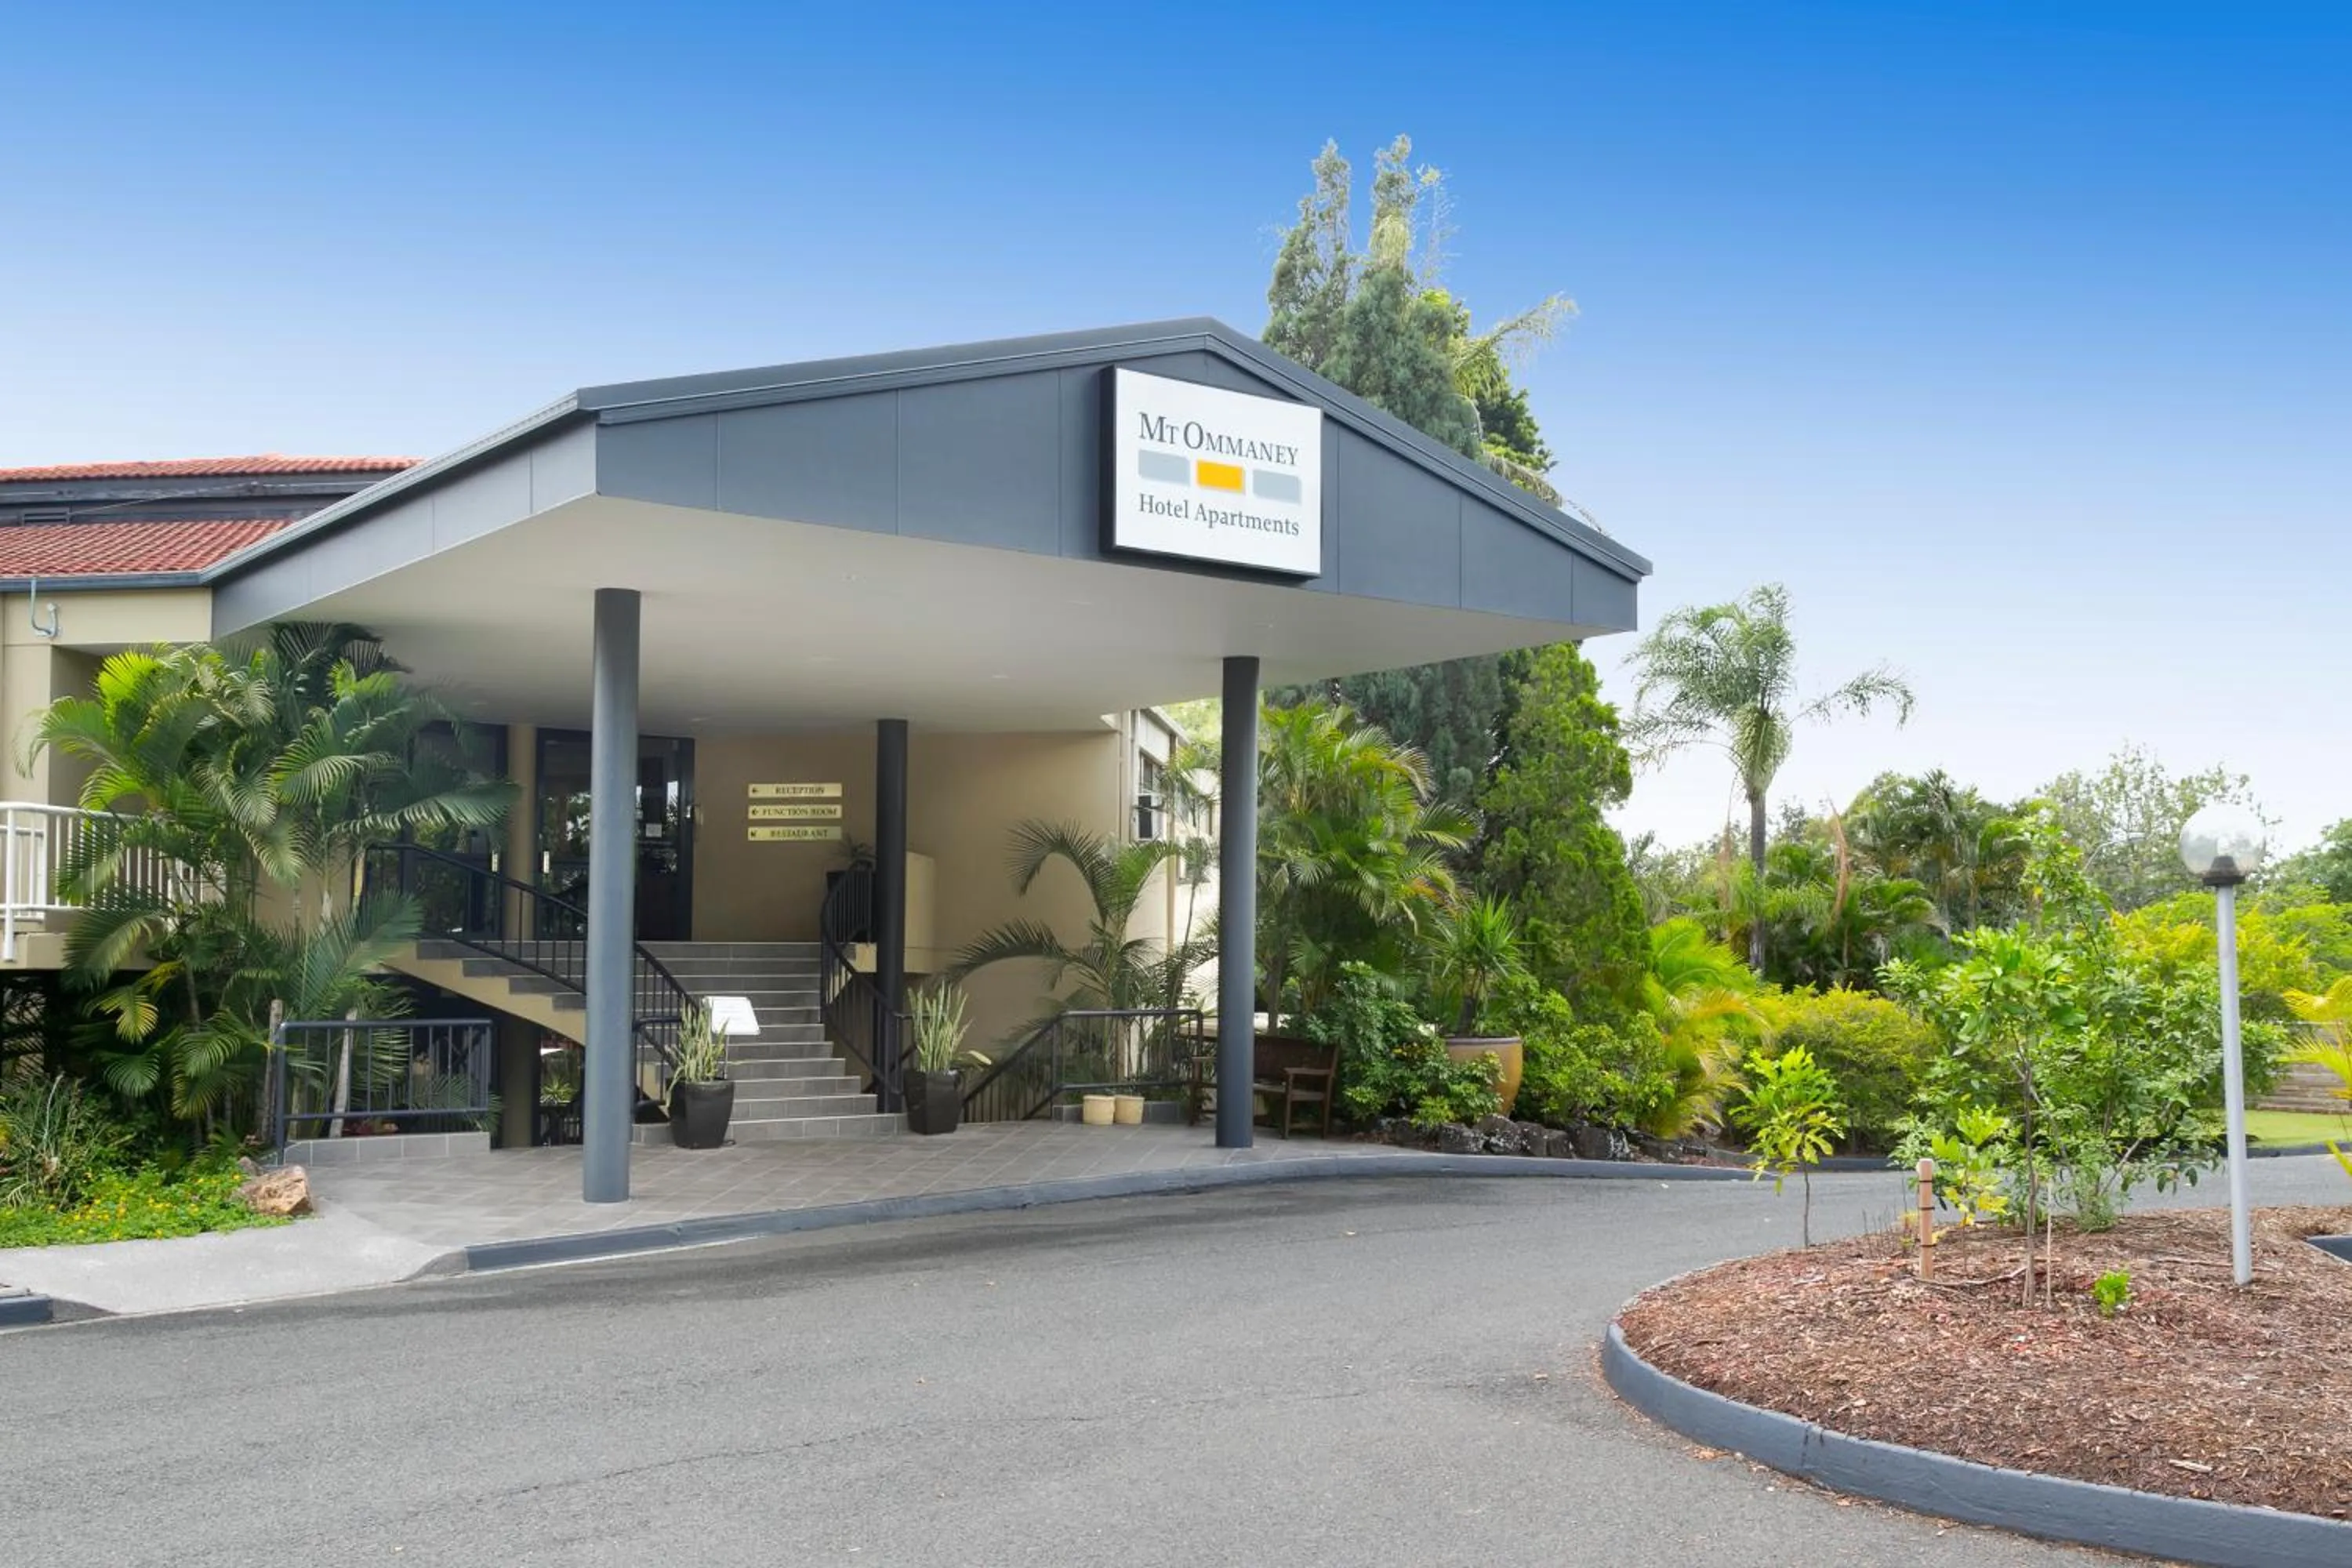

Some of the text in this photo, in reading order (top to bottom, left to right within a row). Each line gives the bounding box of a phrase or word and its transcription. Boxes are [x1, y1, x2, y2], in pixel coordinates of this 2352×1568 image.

[1138, 492, 1300, 536] Hotel Apartments
[775, 786, 826, 795] RECEPTION
[762, 808, 837, 816] FUNCTION ROOM
[770, 829, 829, 838] RESTAURANT
